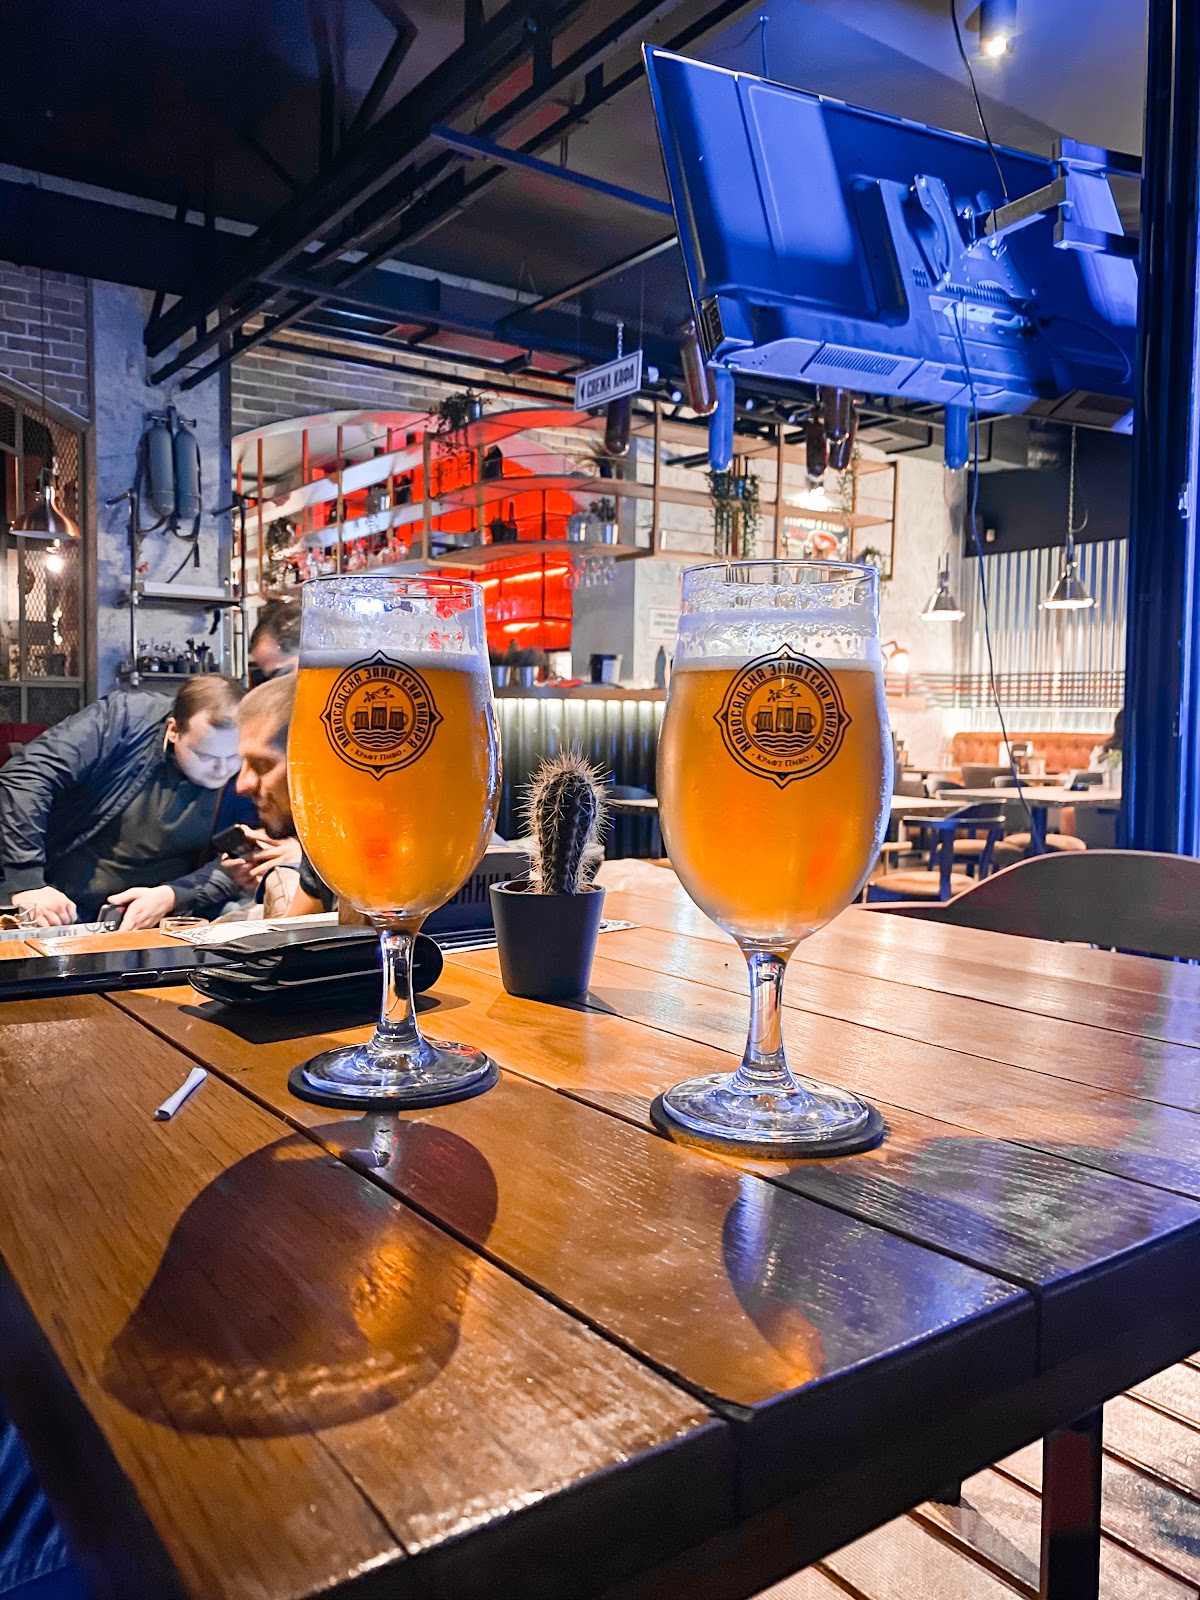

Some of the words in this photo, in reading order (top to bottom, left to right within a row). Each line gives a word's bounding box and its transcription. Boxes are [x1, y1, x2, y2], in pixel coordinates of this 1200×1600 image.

[333, 674, 363, 749] НОВОСАДСКА
[364, 667, 422, 700] ЗАНАТСКА
[408, 701, 428, 749] ПИВАРА
[731, 669, 767, 753] НОВОСАДСКА
[768, 662, 830, 699] ЗАНАТСКА
[815, 701, 837, 754] ПИВАРА
